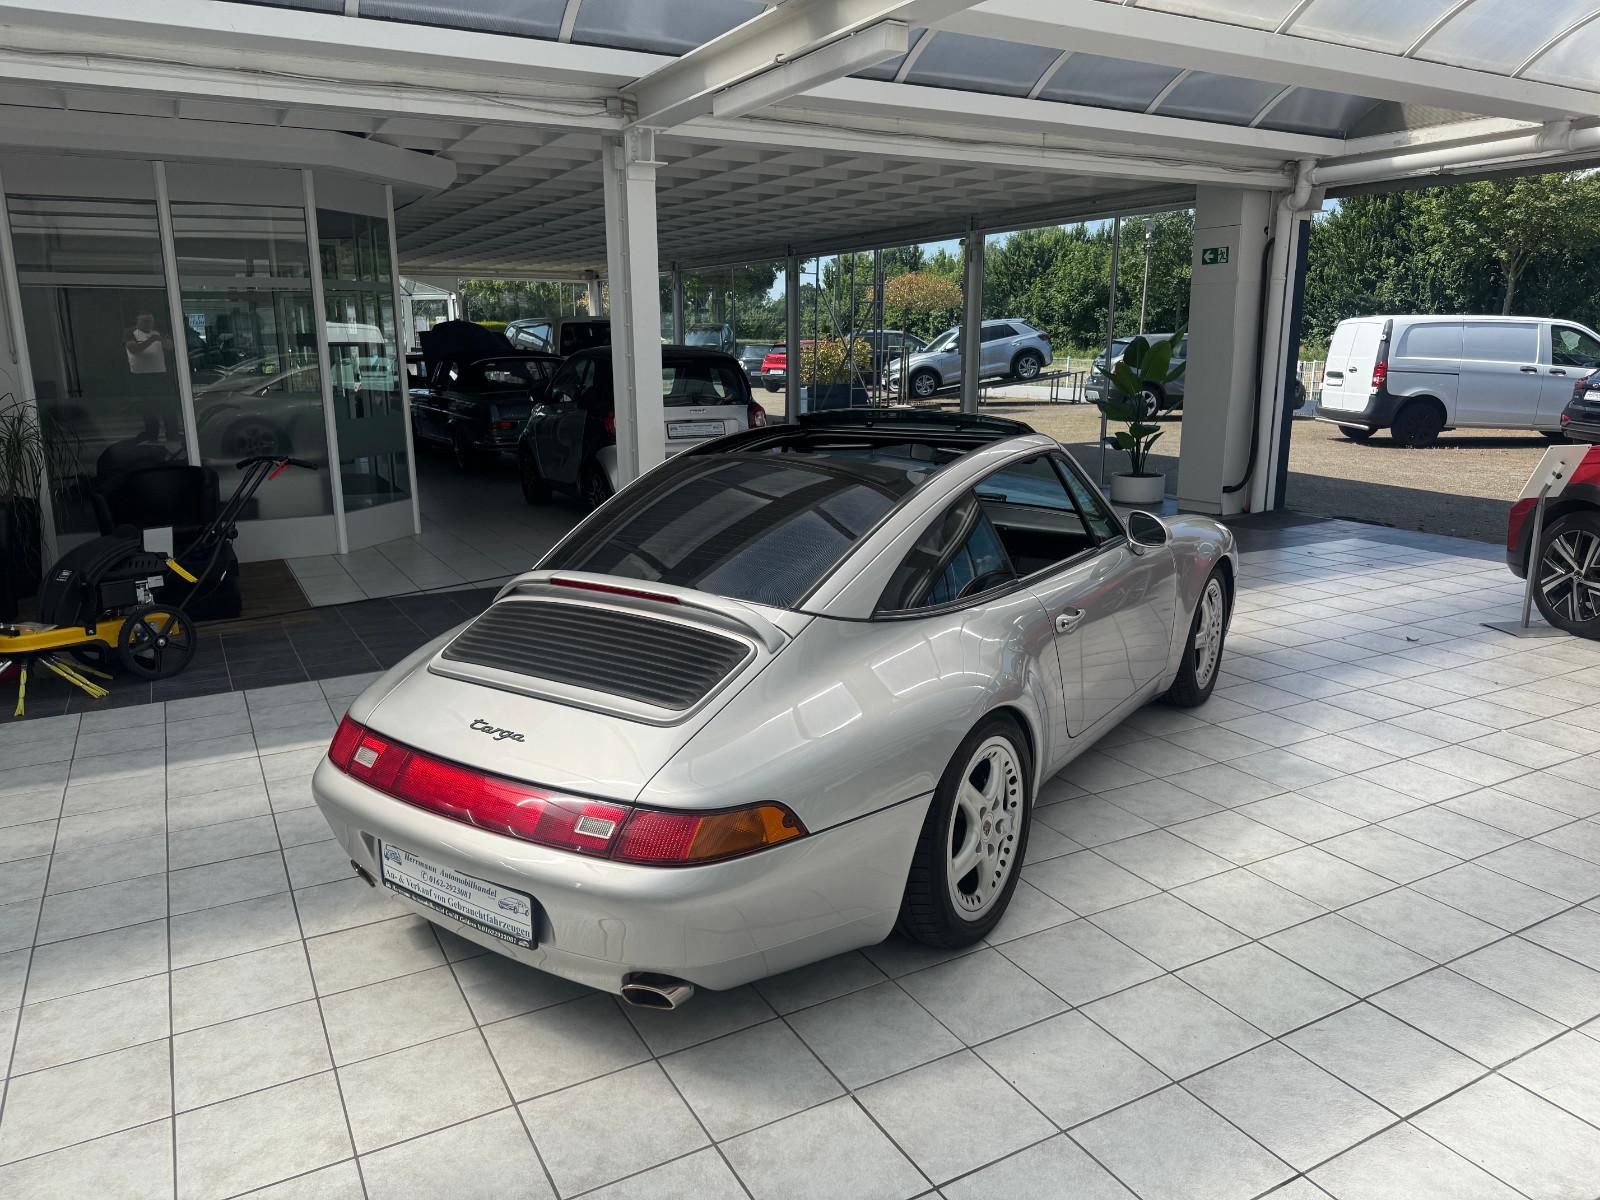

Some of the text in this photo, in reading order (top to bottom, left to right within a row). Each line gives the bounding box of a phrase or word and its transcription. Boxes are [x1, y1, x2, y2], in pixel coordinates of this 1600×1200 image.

[469, 718, 526, 743] targa
[404, 852, 497, 898] Herrmann Automobilhandel
[386, 869, 398, 880] An-
[406, 876, 432, 897] Verkauf
[433, 891, 446, 904] von
[447, 896, 530, 938] Gebrauchtfahrzeugen
